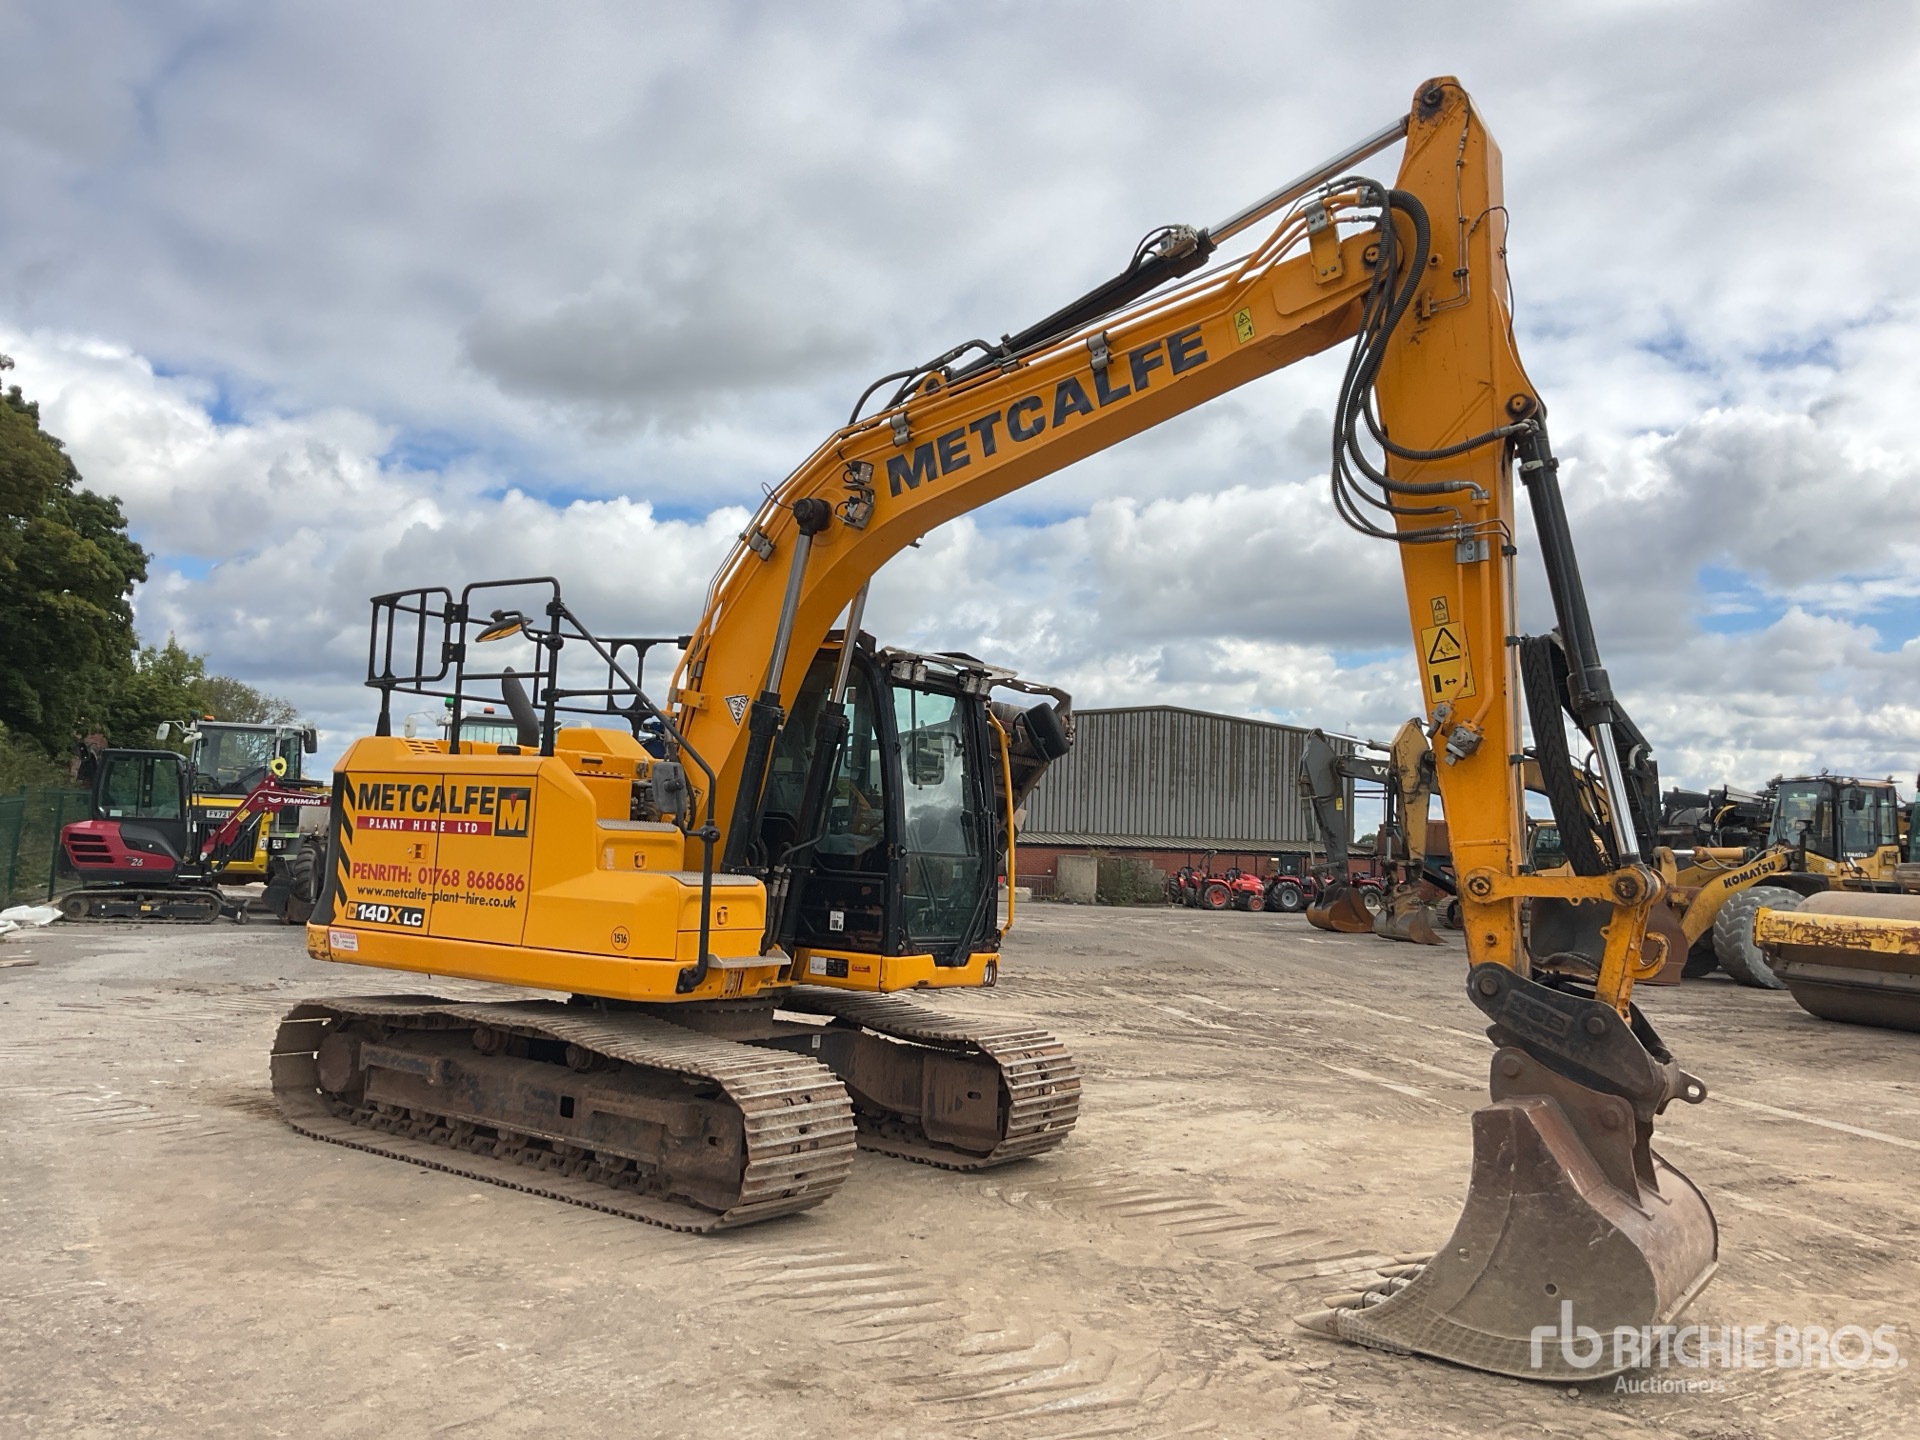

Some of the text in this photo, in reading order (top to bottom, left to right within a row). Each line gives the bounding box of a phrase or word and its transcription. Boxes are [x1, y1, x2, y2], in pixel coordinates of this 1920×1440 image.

[885, 325, 1211, 498] METCALFE
[283, 797, 321, 805] YANMAR
[358, 783, 496, 815] METCALFE
[369, 818, 478, 834] PLANT HIRE LTD
[498, 798, 528, 831] M
[352, 862, 525, 892] PENRITH: 01768 868686
[1723, 861, 1776, 889] KOMATSU
[357, 885, 517, 908] www.metcalfe-plant-hire.co.uk
[403, 912, 422, 926] LC
